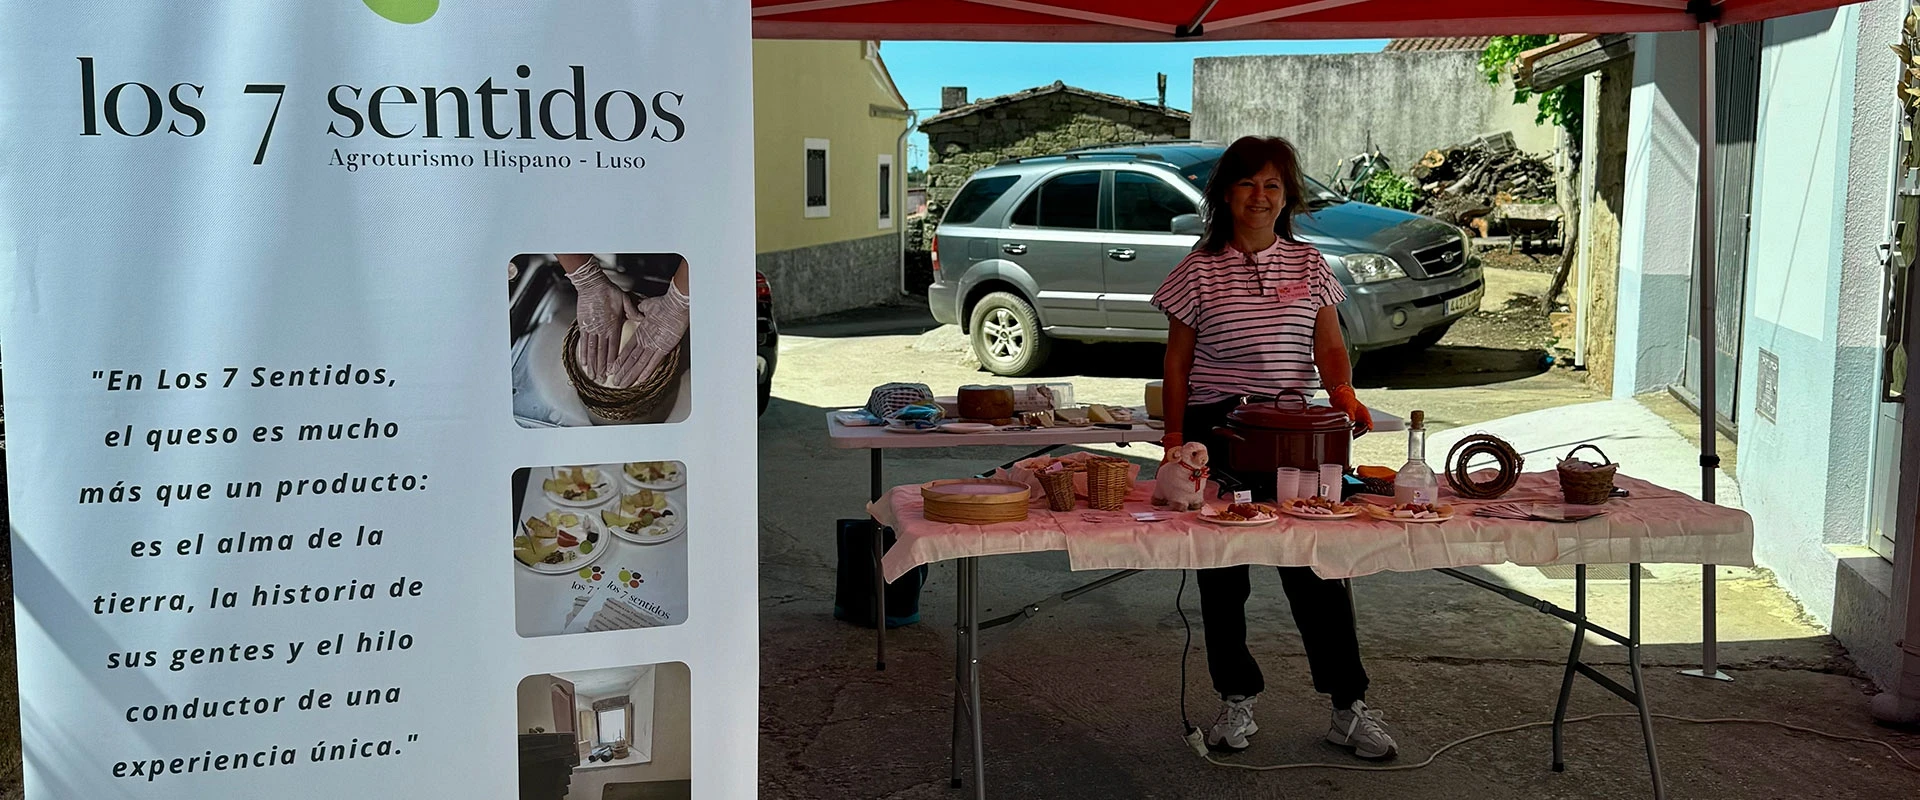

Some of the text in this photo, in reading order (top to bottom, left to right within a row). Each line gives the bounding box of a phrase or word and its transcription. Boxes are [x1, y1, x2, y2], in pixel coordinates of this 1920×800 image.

[76, 56, 687, 167] los 7 sentidos
[328, 148, 475, 173] Agroturismo
[483, 149, 572, 173] Hispano
[595, 150, 646, 170] Luso
[92, 363, 397, 392] "En Los 7 Sentidos,
[104, 417, 399, 452] el queso es mucho
[78, 472, 429, 507] más que un producto:
[130, 525, 384, 558] es el alma de la
[93, 576, 424, 615] tierra, la historia de
[606, 581, 620, 594] los
[619, 591, 628, 599] 7
[628, 594, 671, 619] sentidos
[106, 629, 414, 672] sus gentes y el hilo
[125, 687, 401, 723] conductor de una
[112, 733, 419, 783] experiencia única."
